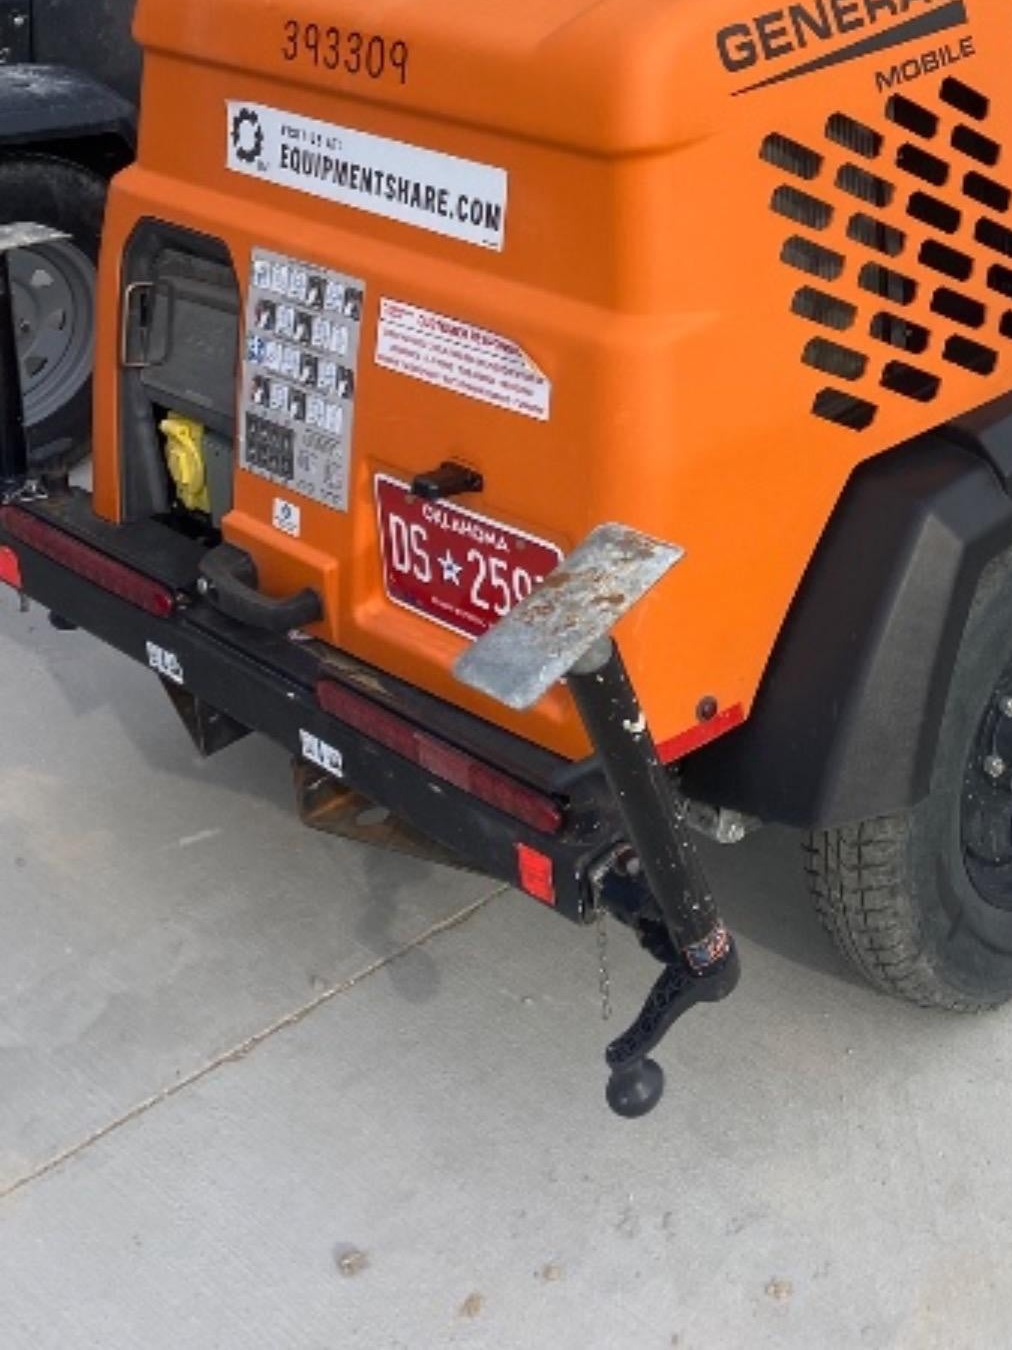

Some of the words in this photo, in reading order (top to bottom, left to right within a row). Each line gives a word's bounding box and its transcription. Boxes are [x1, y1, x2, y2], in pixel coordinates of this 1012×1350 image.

[282, 19, 408, 85] 393309
[875, 35, 976, 93] MOBILE
[279, 143, 502, 232] EQUIPMENTSHARE.COM
[388, 512, 433, 584] DS
[422, 503, 509, 551] OKLAHOMA
